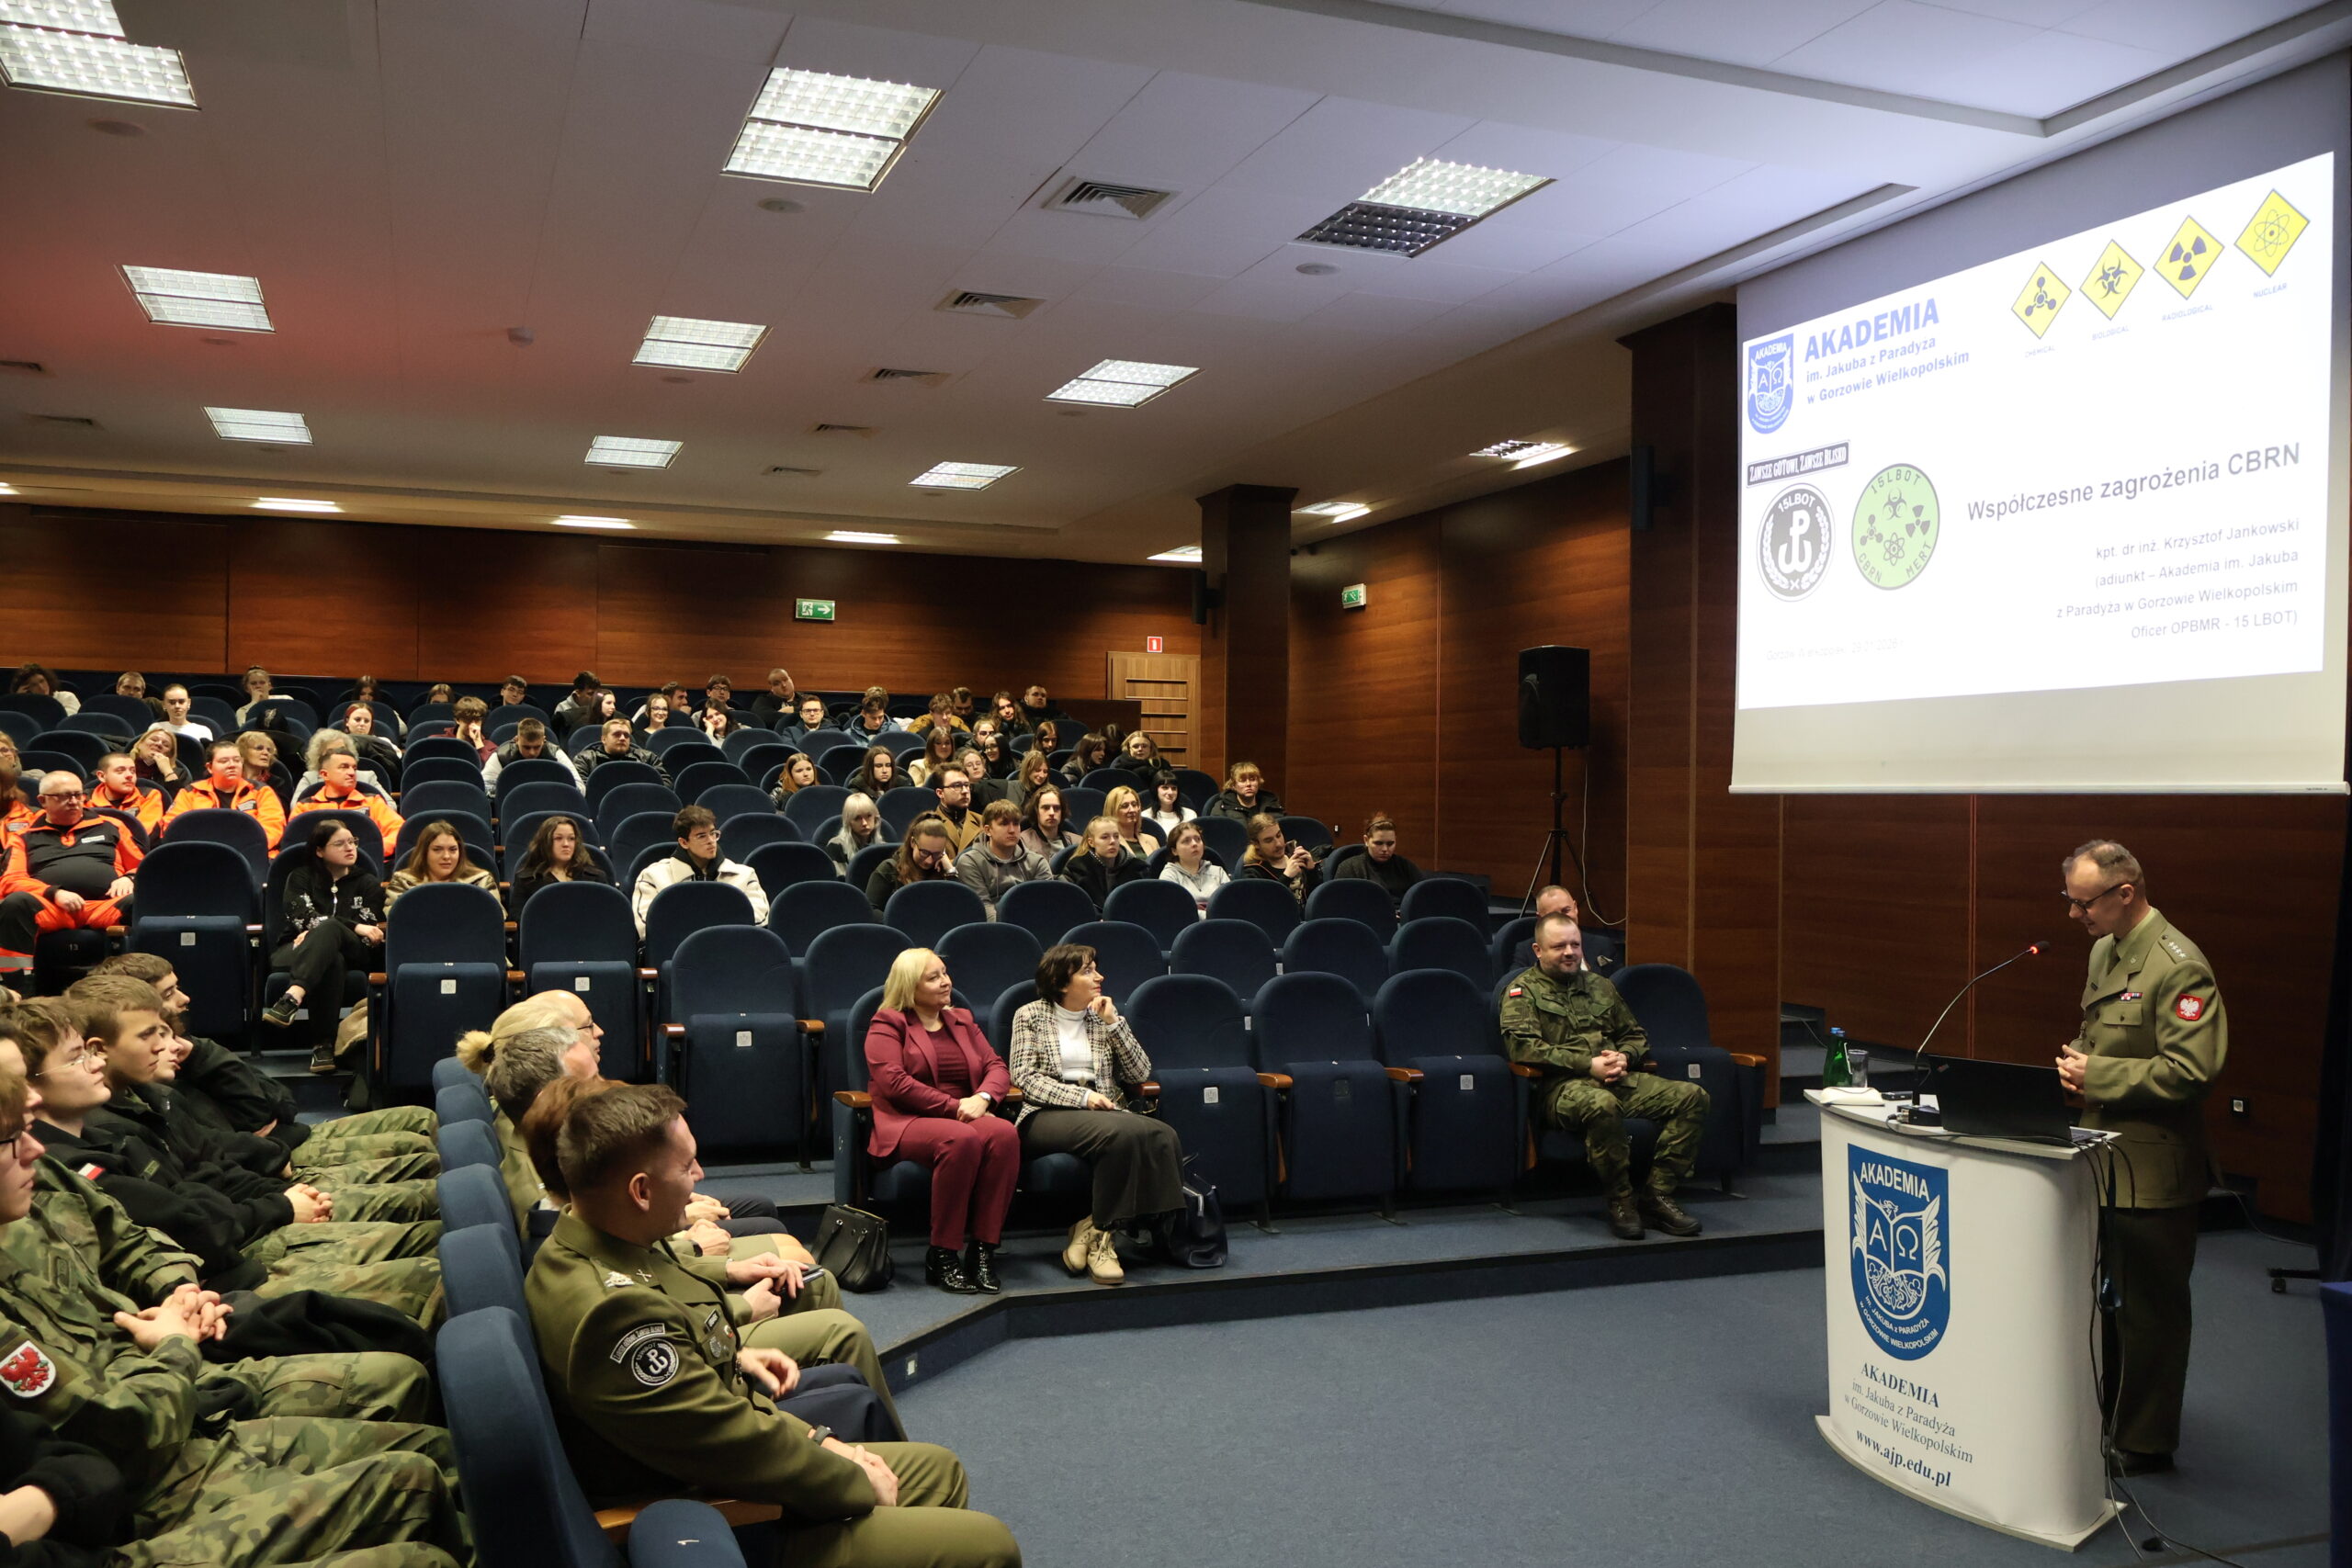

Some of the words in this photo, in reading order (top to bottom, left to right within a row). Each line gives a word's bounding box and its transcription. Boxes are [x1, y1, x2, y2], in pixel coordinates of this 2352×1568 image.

[2253, 283, 2288, 299] NUCLEAR
[1804, 297, 1939, 363] AKADEMIA
[2161, 304, 2213, 321] RADIOLOGICAL
[1755, 342, 1788, 362] AKADEMIA
[1806, 370, 1823, 383] im.
[1826, 357, 1866, 378] Jakuba
[1870, 355, 1876, 366] z
[1879, 336, 1936, 363] Paradyża
[1807, 394, 1815, 405] w
[1819, 377, 1872, 401] Gorzowie
[1876, 352, 1970, 387] Wielkopolskim
[1870, 468, 1922, 494] 15LBOT
[1967, 485, 2093, 522] Współczesne
[2100, 460, 2220, 500] zagrożenia
[2228, 442, 2300, 476] CBRN
[1778, 492, 1816, 513] 15LBOT
[2096, 546, 2118, 561] kpt.
[2121, 544, 2135, 556] dr
[2138, 539, 2161, 554] inż.
[2164, 528, 2223, 549] Krzysztof
[2226, 517, 2300, 541] Jankowski
[1859, 552, 1883, 583] CBRN
[1905, 541, 1932, 578] MERT
[2095, 570, 2146, 589] (adiunkt
[2158, 560, 2220, 579] Akademia
[2224, 556, 2245, 570] im.
[2248, 549, 2299, 568] Jakuba
[2056, 608, 2064, 618] z
[2066, 600, 2120, 617] Paradyża
[2124, 602, 2135, 612] w
[2138, 592, 2195, 610] Gorzowie
[2199, 581, 2298, 603] Wielkopolskim
[2131, 625, 2168, 639] Oficer
[2170, 617, 2221, 635] OPBMR
[2234, 615, 2249, 628] 15
[2254, 609, 2298, 627] LBOT)
[1860, 1161, 1930, 1202] AKADEMIA
[1863, 1308, 1891, 1344] GORZOWIE
[1890, 1328, 1939, 1349] WIELKOPOLSKIM
[1871, 1308, 1894, 1331] JAKUBA
[1898, 1317, 1930, 1335] PARADYŻA
[1860, 1362, 1939, 1409] AKADEMIA
[1844, 1393, 1850, 1404] w
[1850, 1396, 1889, 1428] Gorzowie
[1892, 1417, 1974, 1464] Wielkopolskim
[1852, 1378, 1864, 1396] im.
[1865, 1386, 1895, 1413] Jakuba
[1896, 1405, 1904, 1416] z
[1905, 1405, 1956, 1438] Paradyża
[1856, 1429, 1951, 1488] www.ajp.edu.pl
